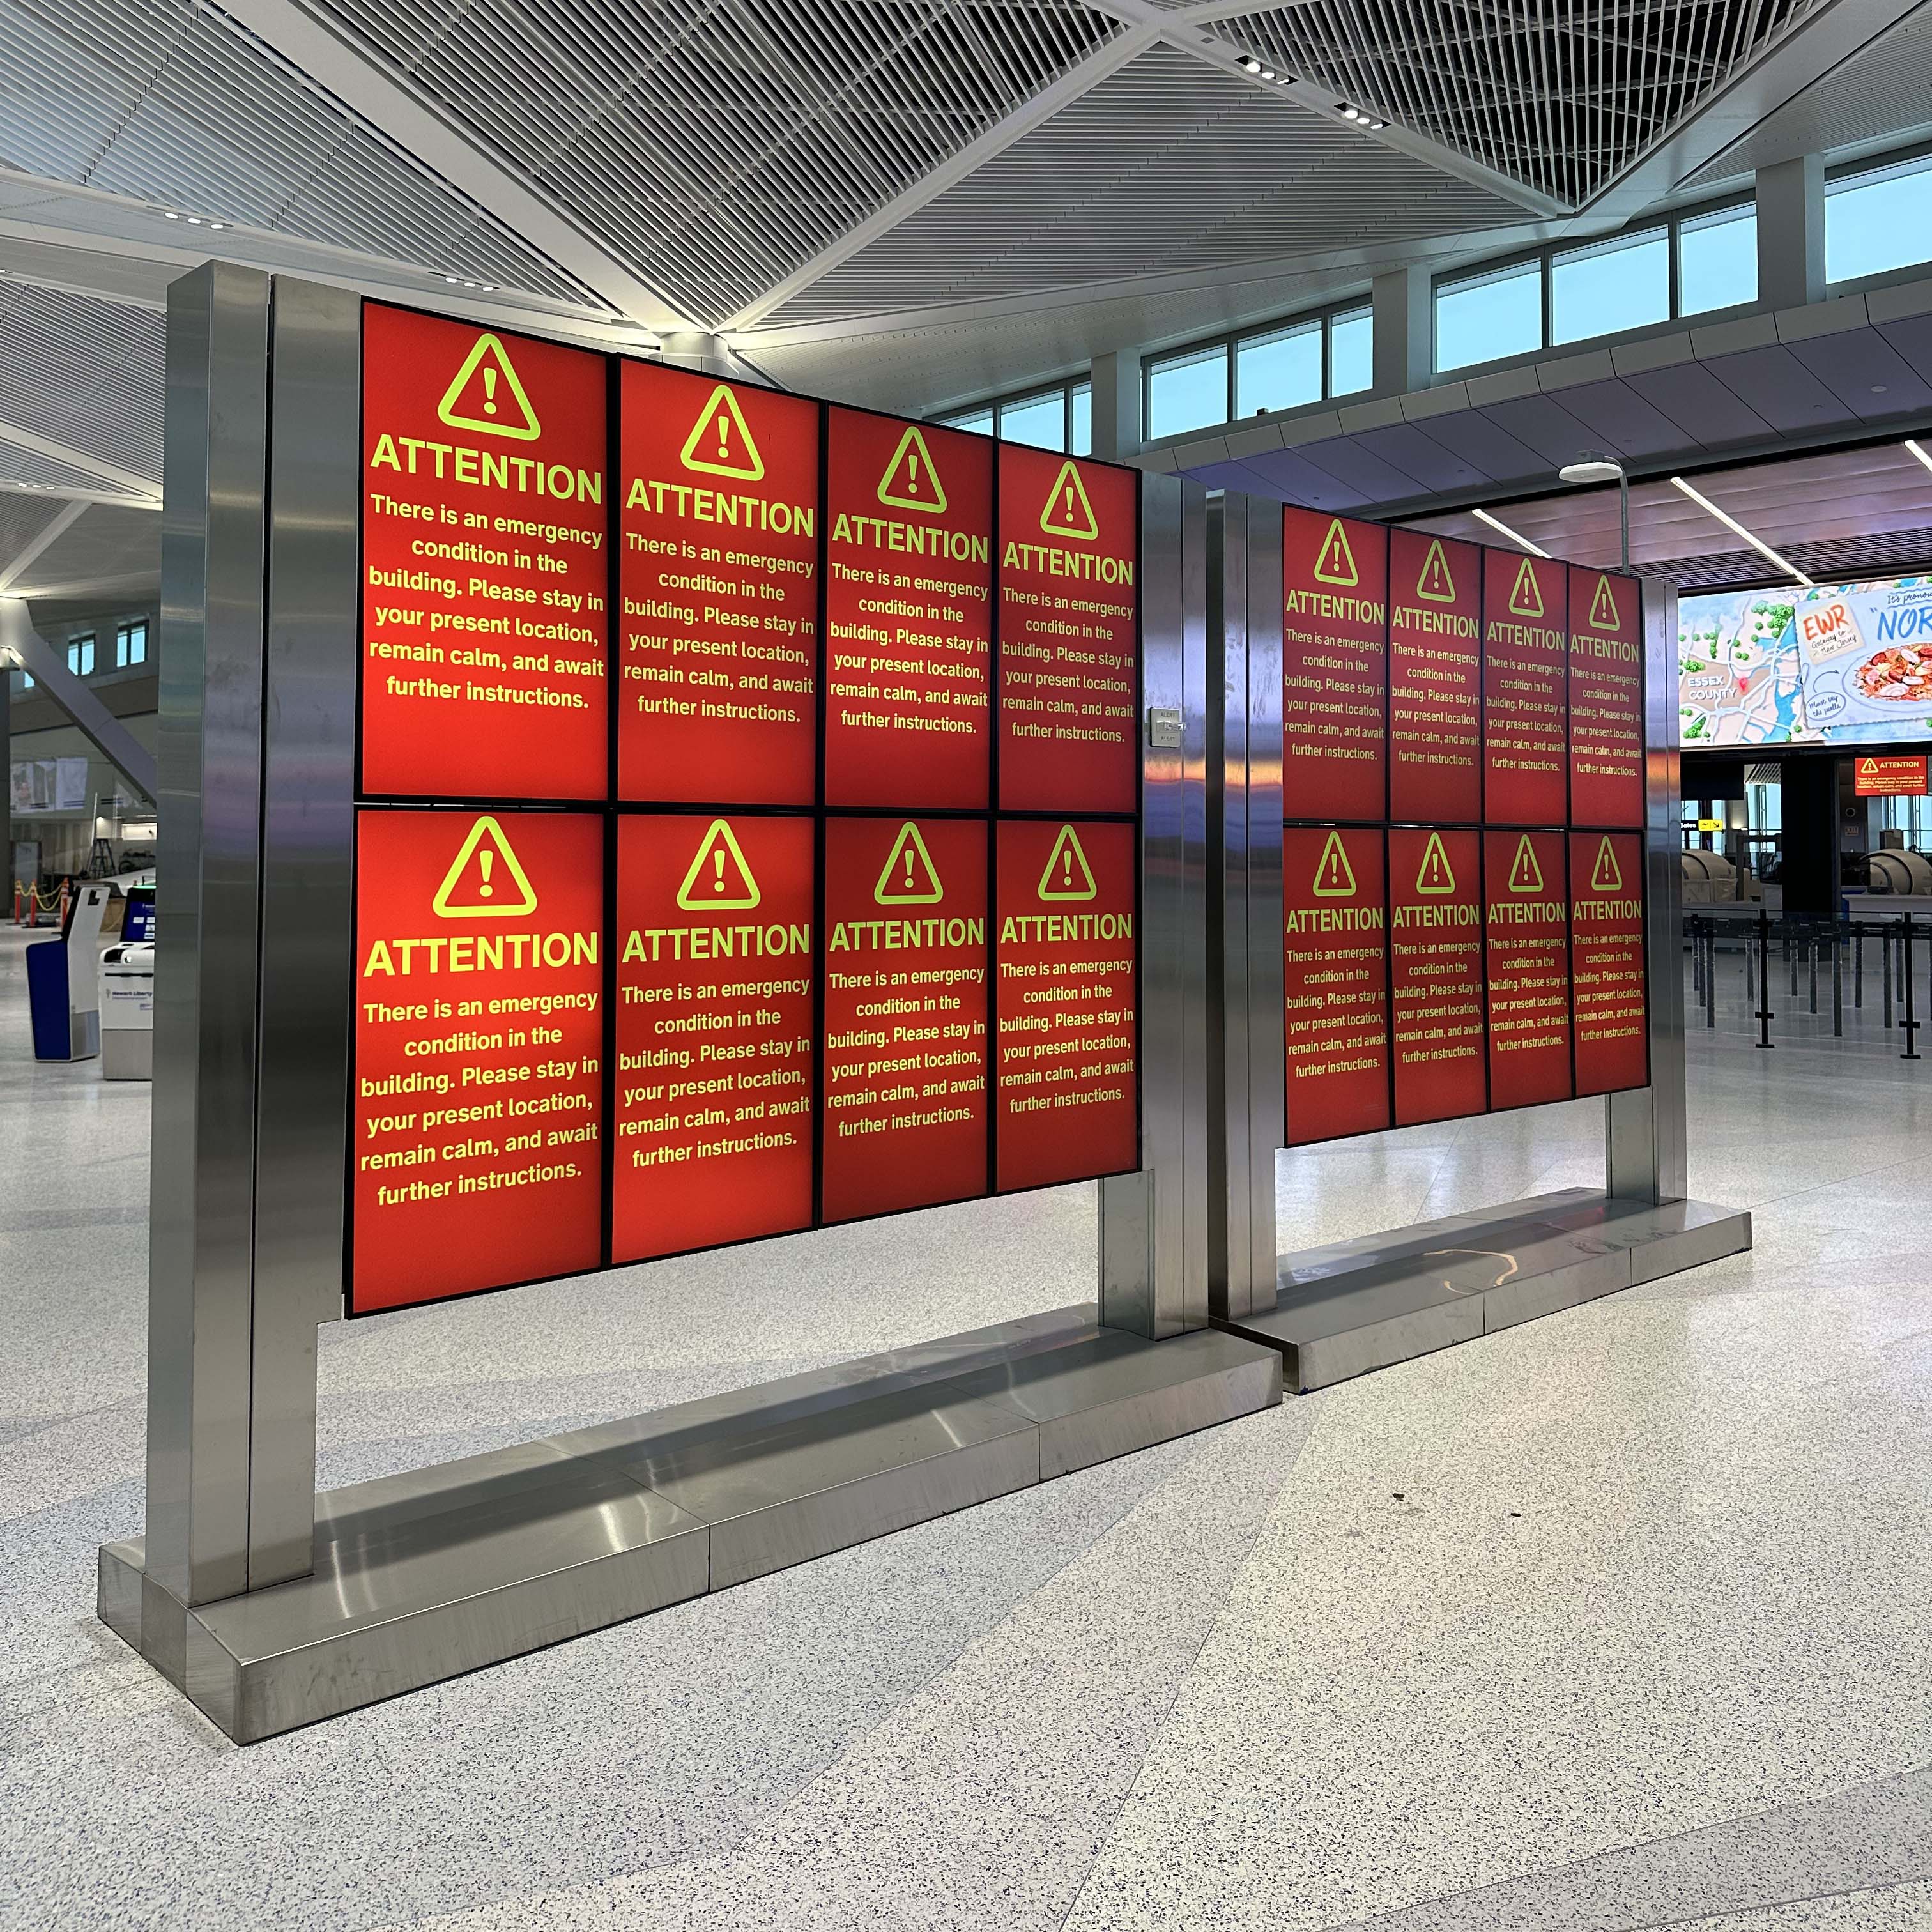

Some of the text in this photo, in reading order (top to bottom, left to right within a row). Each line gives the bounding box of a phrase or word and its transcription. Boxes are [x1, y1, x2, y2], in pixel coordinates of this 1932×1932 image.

[371, 433, 601, 504] ATTENTION
[625, 478, 813, 537] ATTENTION
[370, 493, 602, 549] There is an emergency
[832, 513, 988, 564] ATTENTION
[1003, 541, 1132, 585] ATTENTION
[369, 565, 603, 613] building. Please stay in
[659, 573, 785, 601] condition in the
[1002, 586, 1133, 620] There is an emergency
[1286, 589, 1384, 625] ATTENTION
[375, 606, 598, 647] your present location,
[1392, 606, 1478, 639] ATTENTION
[1803, 605, 1850, 640] EWR
[831, 621, 988, 654] building. Please stay in
[1487, 621, 1565, 651] ATTENTION
[1570, 634, 1639, 662] ATTENTION
[1812, 634, 1837, 648] Gateway
[1837, 634, 1857, 648] Jersey
[1392, 642, 1479, 667] There is an emergency
[624, 665, 813, 693] remain calm, and await
[1006, 671, 1130, 694] your present location,
[1285, 674, 1384, 697] building. Please stay in
[1500, 678, 1552, 693] condition in the
[1688, 675, 1724, 687] ESSEX
[1689, 687, 1737, 700] COUNTY
[841, 710, 976, 733] further instructions.
[1394, 709, 1477, 726] your present location,
[1570, 705, 1598, 720] building.
[1599, 707, 1620, 719] Please
[1621, 711, 1634, 723] stay
[1292, 743, 1377, 760] further instructions.
[1487, 737, 1565, 752] remain calm, and await
[1577, 762, 1637, 776] further instructions.
[1286, 907, 1383, 933] ATTENTION
[1393, 904, 1479, 928] ATTENTION
[1488, 902, 1565, 924] ATTENTION
[1573, 900, 1641, 921] ATTENTION
[829, 917, 984, 951] ATTENTION
[1000, 913, 1131, 943] ATTENTION
[1573, 933, 1642, 945] There is an emergency
[363, 931, 597, 977] ATTENTION
[622, 924, 809, 962] ATTENTION
[1287, 947, 1383, 962] There is an emergency
[829, 968, 984, 988] There is an emergency
[1409, 962, 1467, 976] condition in the
[1574, 972, 1601, 985] building.
[1602, 970, 1623, 981] Please
[1624, 970, 1637, 981] stay
[1023, 984, 1112, 1003] condition in the
[1489, 975, 1567, 992] building. Please stay in
[1576, 988, 1643, 1005] your present location,
[1290, 1011, 1383, 1035] your present location,
[1395, 1022, 1483, 1042] remain calm, and await
[404, 1026, 562, 1056] condition in the
[620, 1036, 809, 1070] building. Please stay in
[1496, 1034, 1564, 1051] further instructions.
[831, 1049, 981, 1082] your present location,
[1000, 1058, 1134, 1087] remain calm, and await
[361, 1123, 597, 1171] remain calm, and await
[632, 1131, 797, 1167] further instructions.
